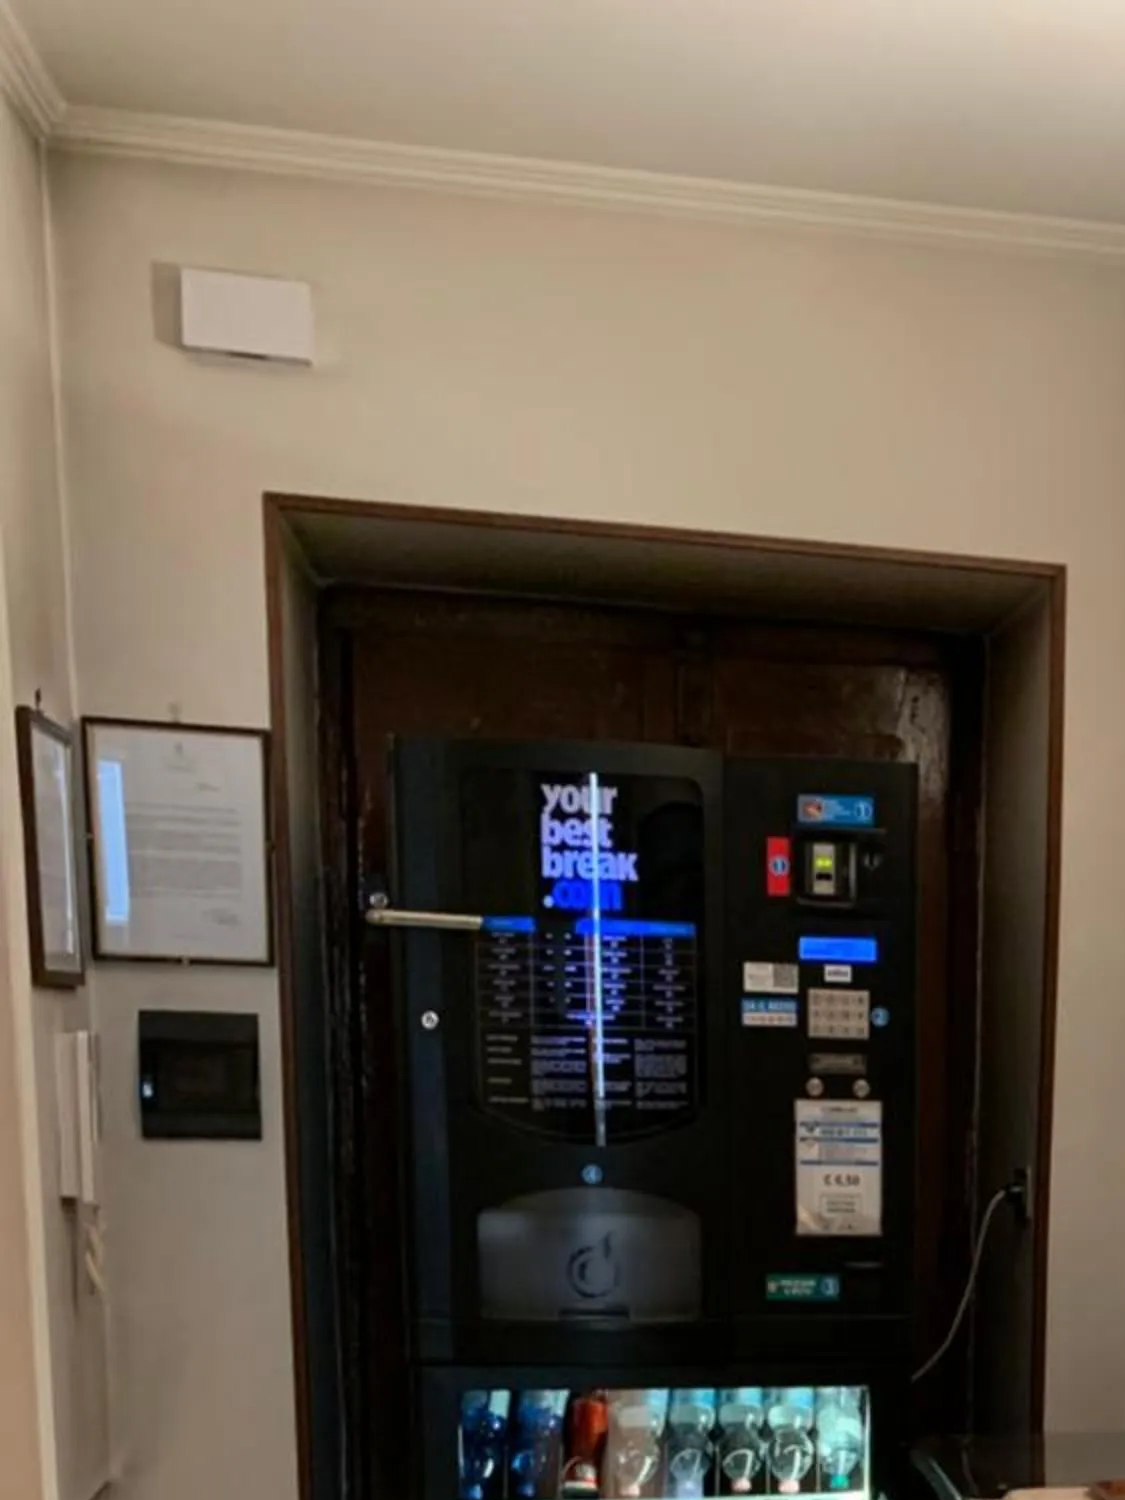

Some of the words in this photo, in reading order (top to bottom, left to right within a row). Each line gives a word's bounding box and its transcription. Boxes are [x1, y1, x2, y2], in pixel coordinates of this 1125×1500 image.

[541, 783, 618, 814] your
[541, 812, 613, 848] best
[542, 845, 639, 881] break
